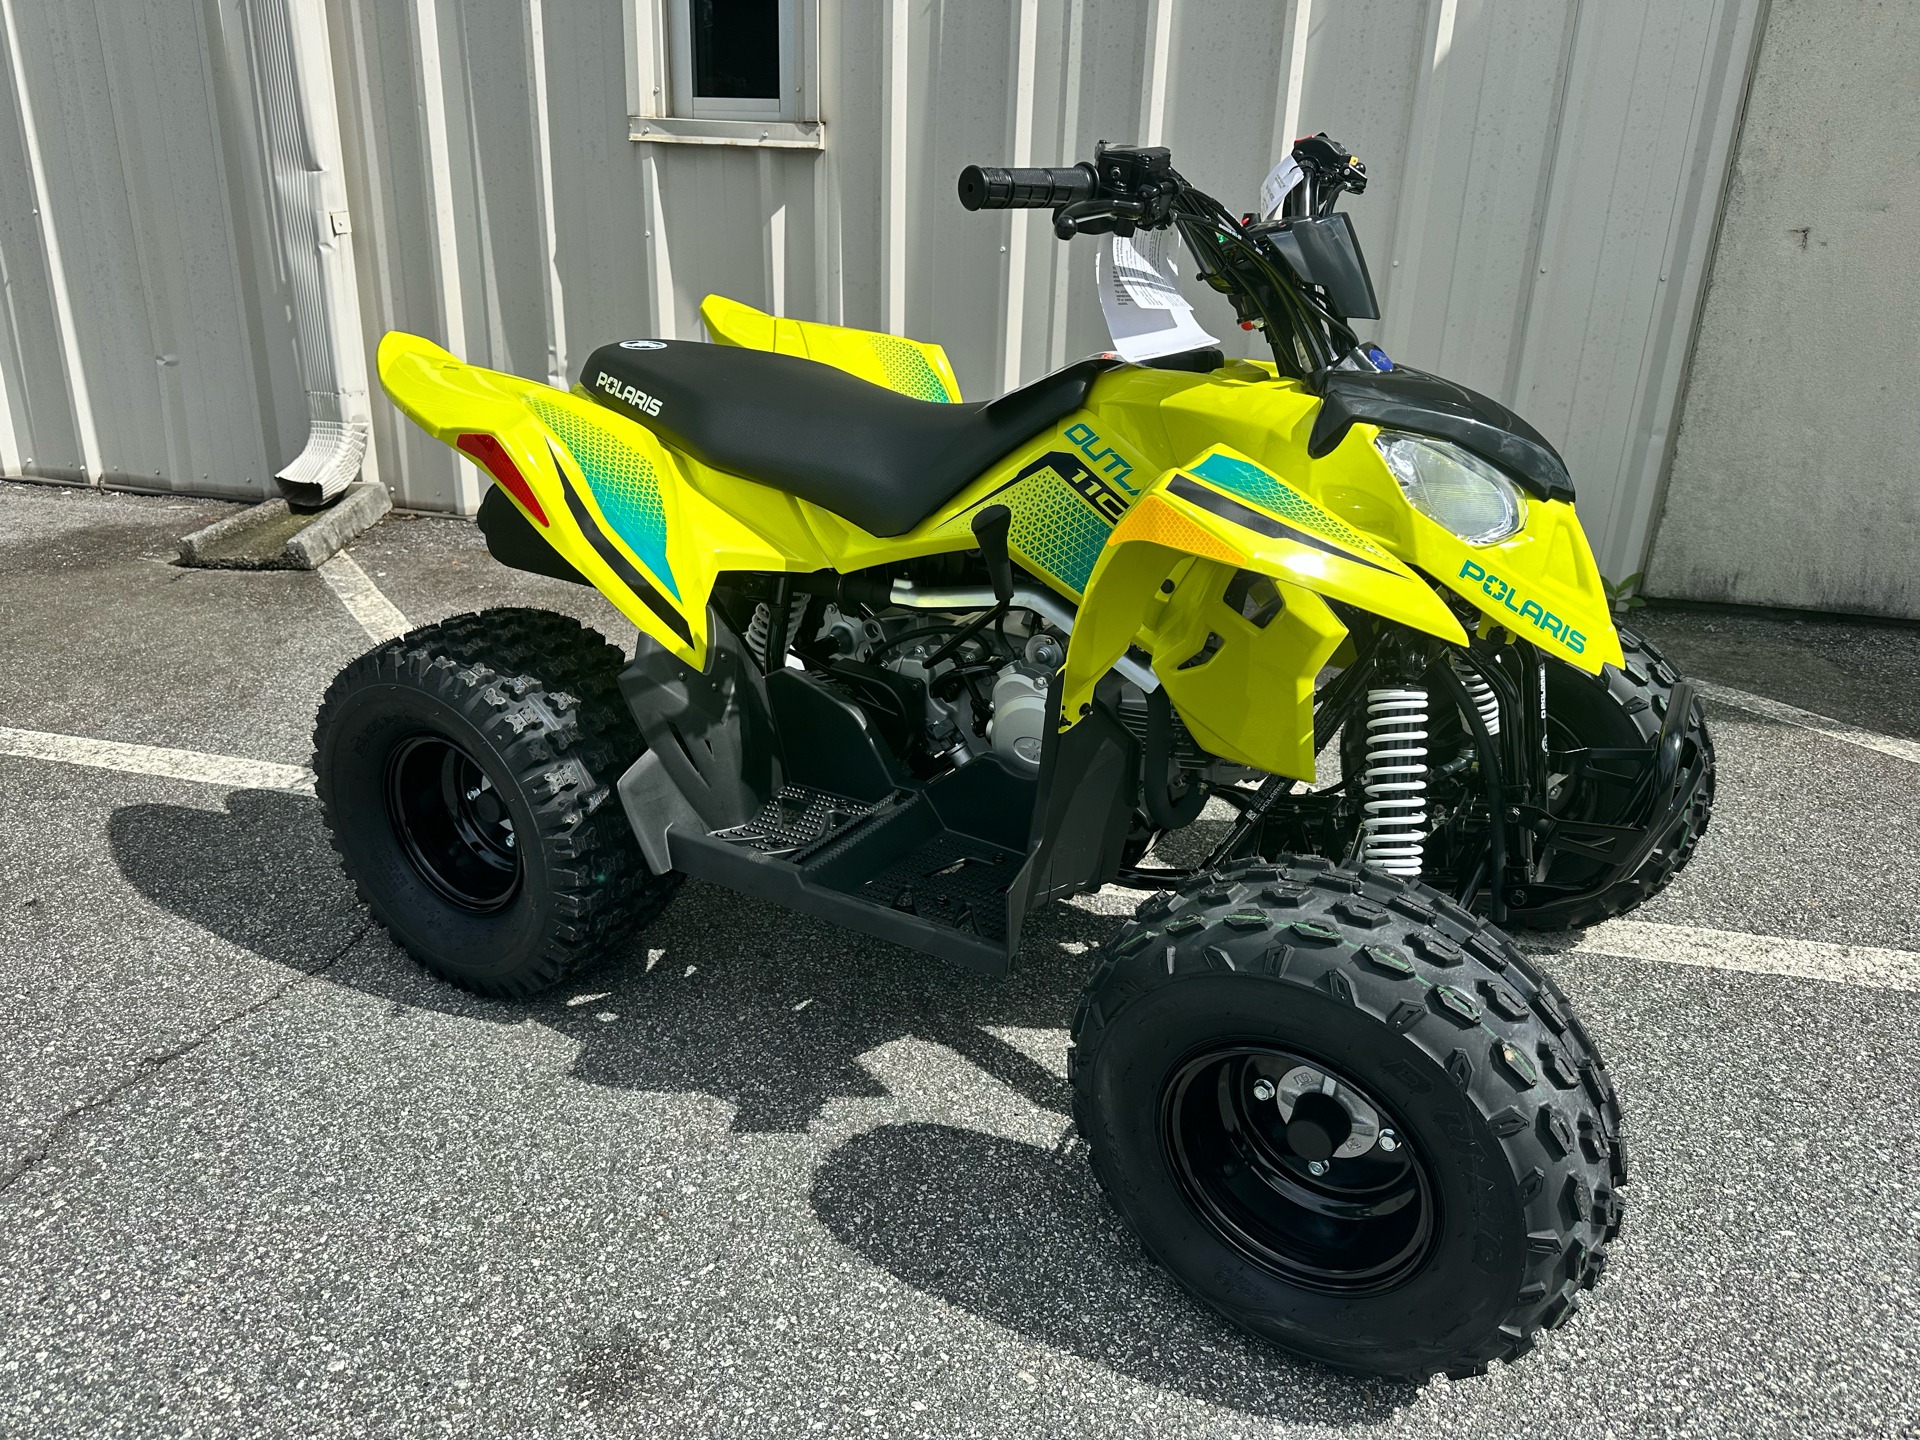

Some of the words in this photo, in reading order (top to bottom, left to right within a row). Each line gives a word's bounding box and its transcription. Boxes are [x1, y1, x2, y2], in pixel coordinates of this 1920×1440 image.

[595, 371, 664, 417] POLARIS
[1063, 423, 1142, 496] OUTL
[1458, 559, 1587, 654] POLARIS
